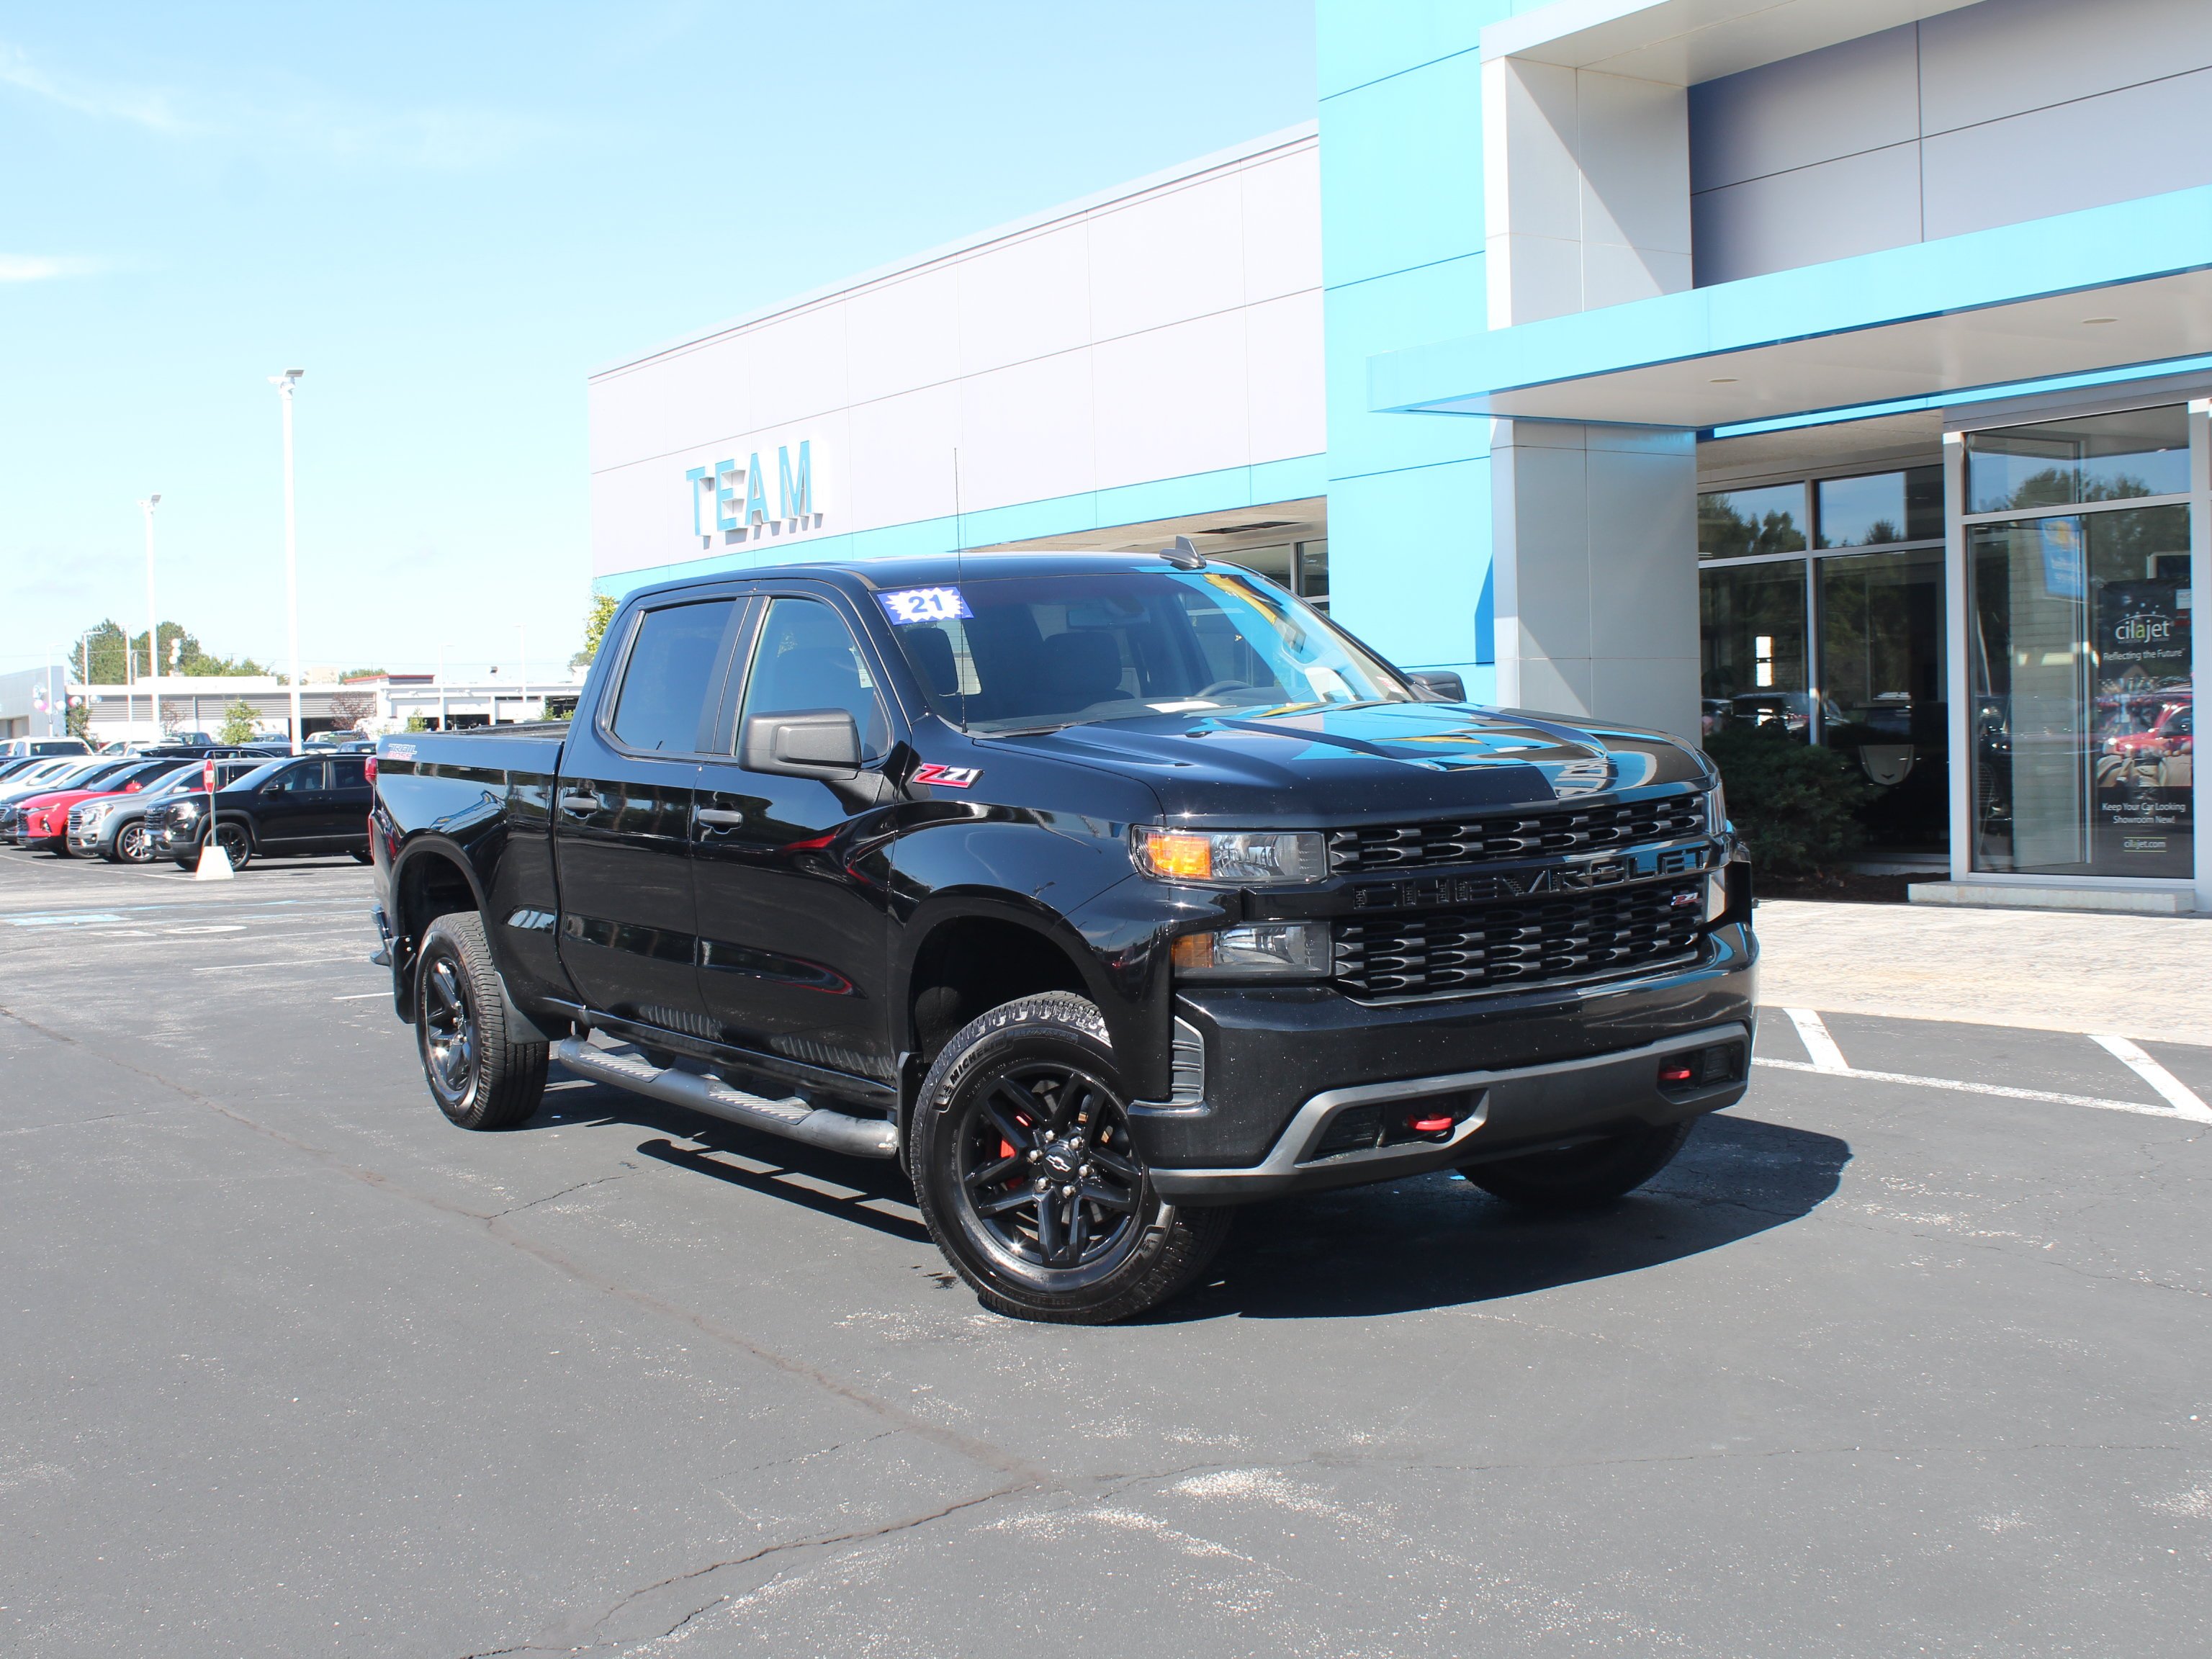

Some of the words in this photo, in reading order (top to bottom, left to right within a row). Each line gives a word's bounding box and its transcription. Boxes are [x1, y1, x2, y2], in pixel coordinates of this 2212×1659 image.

[685, 440, 812, 536] TEAM
[908, 594, 943, 613] 21
[2115, 619, 2170, 643] cilajet
[2103, 651, 2142, 660] Reflecting
[2143, 649, 2157, 658] the
[2157, 649, 2182, 657] Future
[387, 752, 413, 760] BOSS
[388, 743, 418, 755] TRAIL
[912, 763, 983, 789] Z71
[2102, 803, 2123, 812] Keep
[2141, 802, 2154, 811] Car
[2155, 802, 2186, 812] Looking
[2113, 815, 2154, 824] Showroom
[2155, 815, 2175, 824] New!
[2123, 839, 2166, 850] cilajet.com
[1353, 846, 1711, 909] CHEVROLET
[1671, 892, 1699, 906] Z71
[949, 1033, 1005, 1085] MICHELIN
